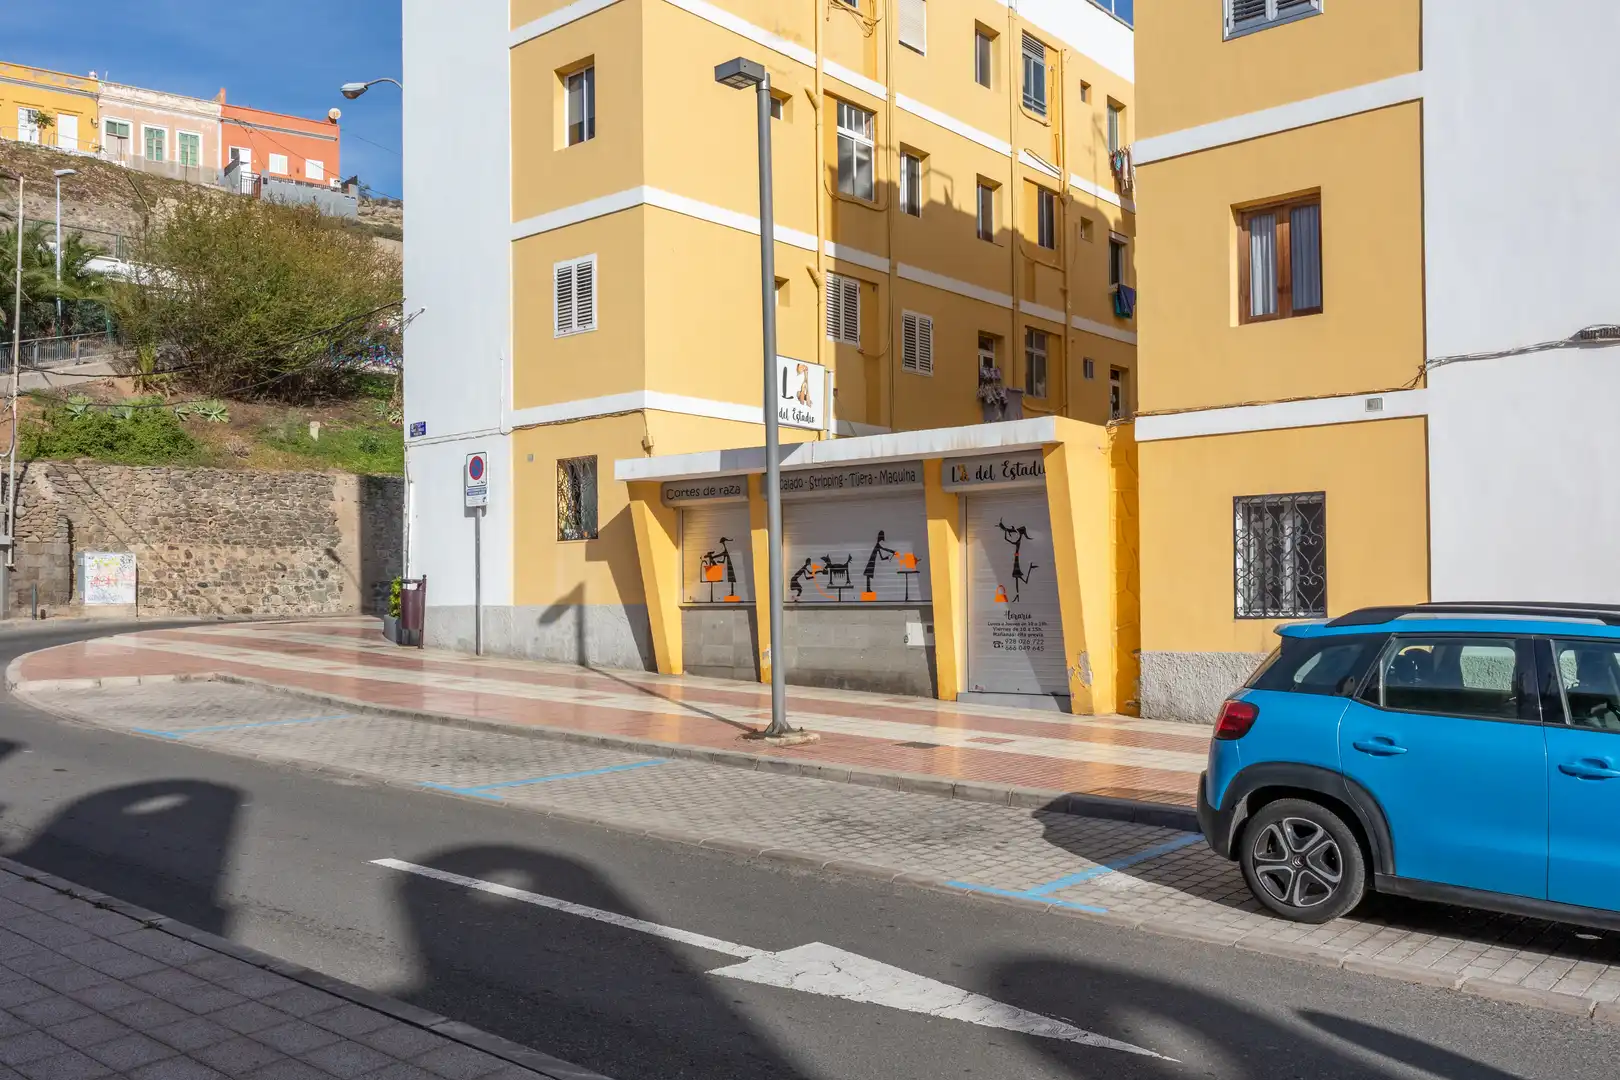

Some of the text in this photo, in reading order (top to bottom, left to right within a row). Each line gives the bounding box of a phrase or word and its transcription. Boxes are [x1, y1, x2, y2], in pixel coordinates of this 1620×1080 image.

[779, 407, 815, 424] del Estadio
[809, 474, 843, 491] Stripping
[849, 472, 873, 487] Tijera
[880, 468, 916, 485] Maquina
[975, 464, 995, 481] del
[666, 485, 741, 500] Cortes de raza
[1004, 610, 1032, 620] Horario
